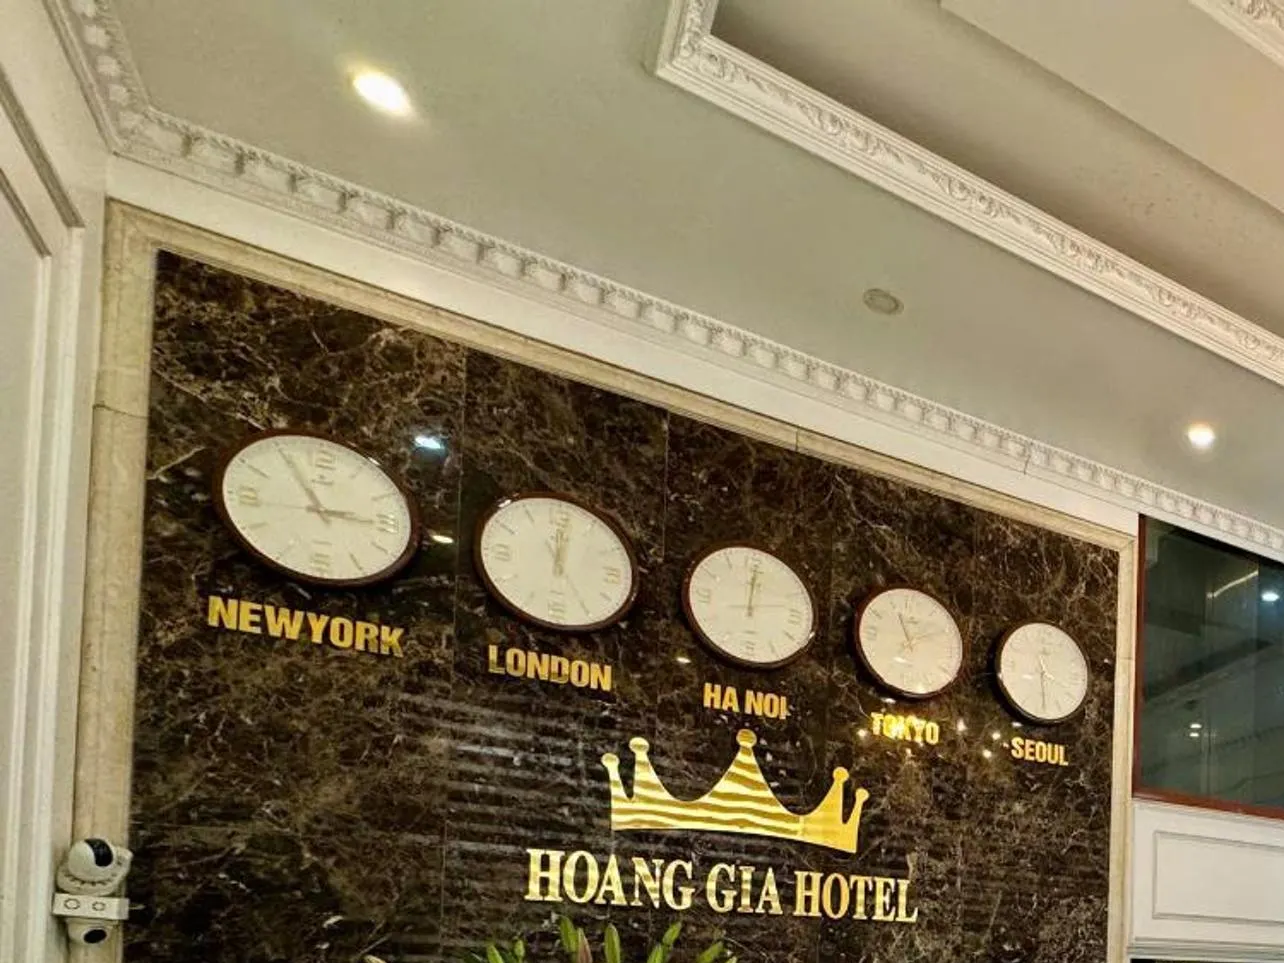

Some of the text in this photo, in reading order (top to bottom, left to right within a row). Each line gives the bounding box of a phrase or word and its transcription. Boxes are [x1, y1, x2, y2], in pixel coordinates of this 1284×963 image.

[208, 595, 404, 658] NEWYORK
[488, 645, 612, 692] LONDON
[702, 682, 787, 720] HA NOI
[870, 711, 940, 745] TOKYO
[1011, 736, 1069, 766] SEOUL
[524, 848, 919, 923] HOANG GIA HOTEL
